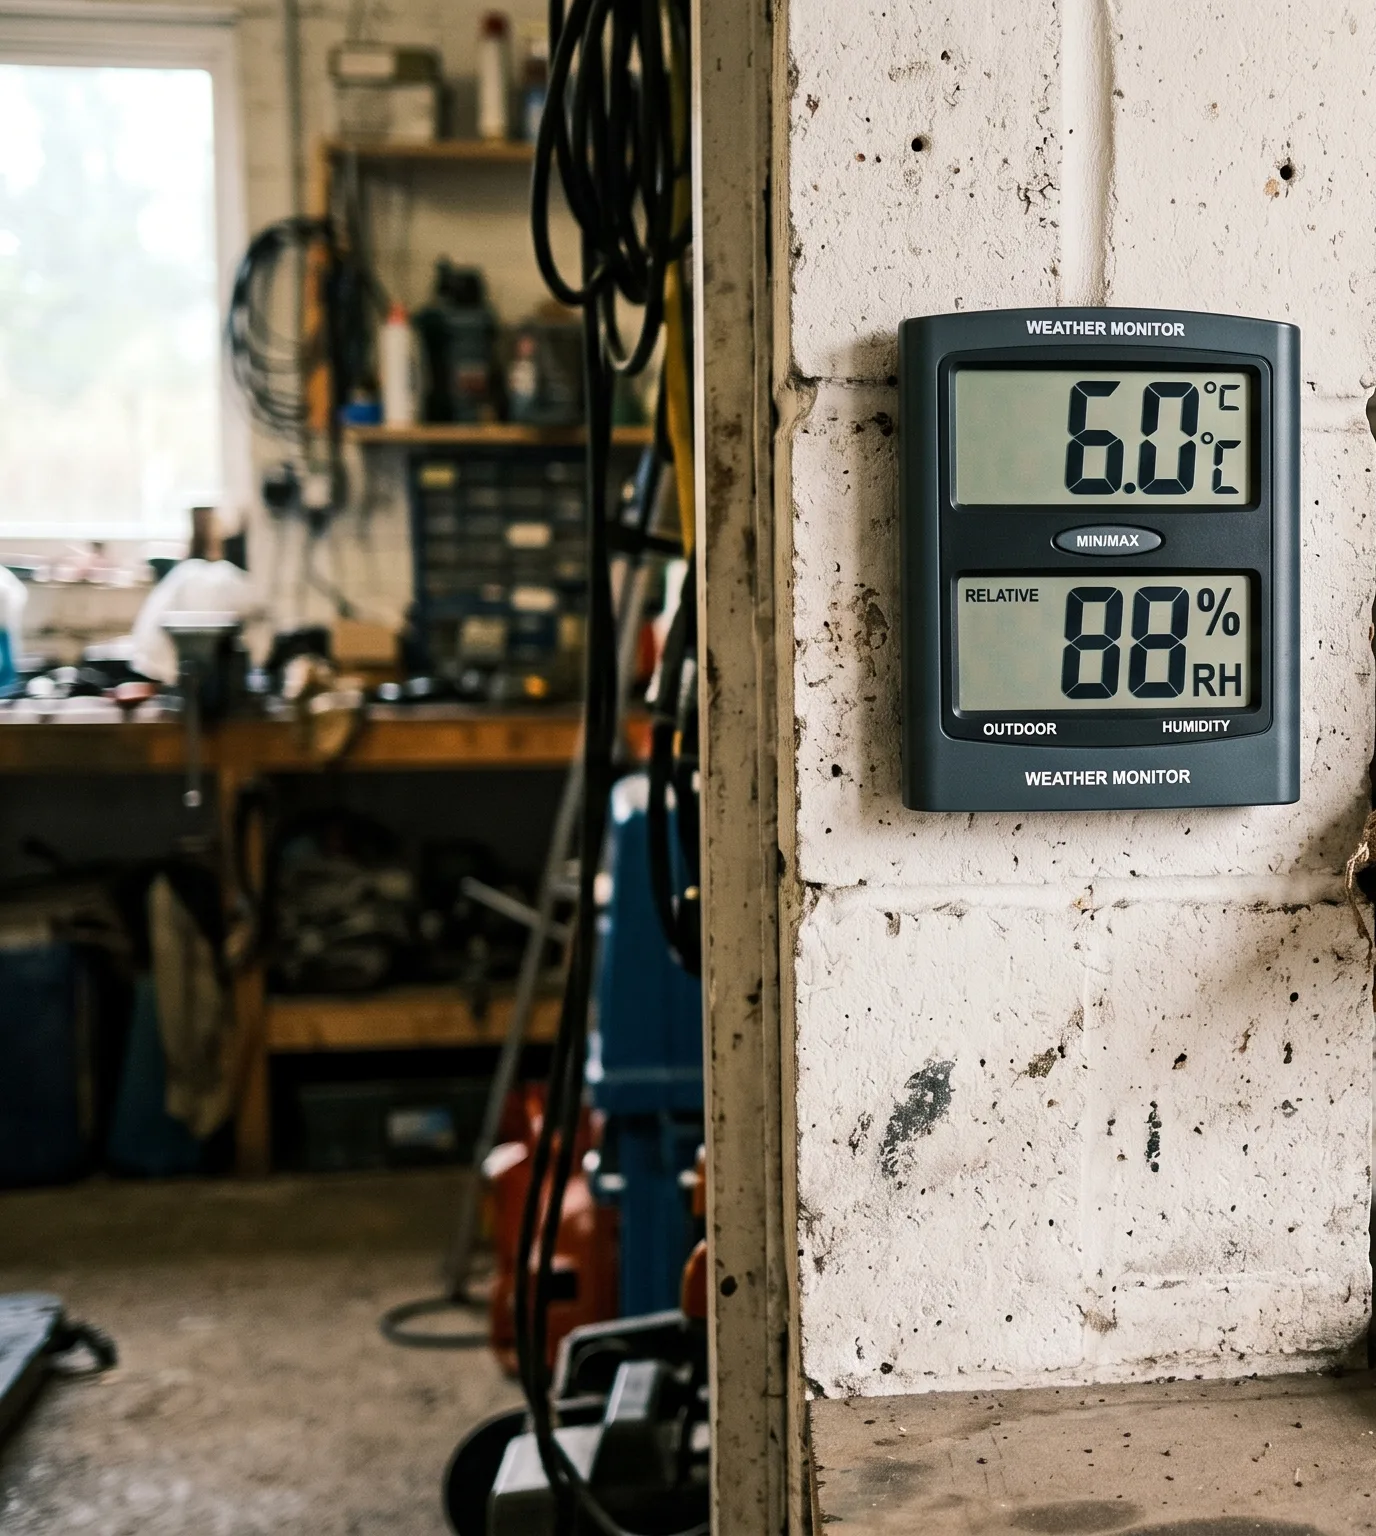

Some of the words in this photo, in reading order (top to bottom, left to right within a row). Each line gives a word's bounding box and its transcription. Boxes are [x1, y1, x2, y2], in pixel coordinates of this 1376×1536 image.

[1026, 320, 1107, 336] WEATHER
[1110, 321, 1186, 337] MONITOR
[1064, 380, 1200, 496] 6.0
[1076, 534, 1140, 548] MIN/MAX
[965, 588, 1039, 603] RELATIVE
[1060, 585, 1191, 700] 88
[1196, 587, 1241, 637] %
[1193, 663, 1242, 698] RH
[983, 722, 1058, 736] OUTDOOR
[1162, 719, 1231, 733] HUMIDITY
[1025, 771, 1108, 786] WEATHER
[1112, 769, 1191, 785] MONITOR
